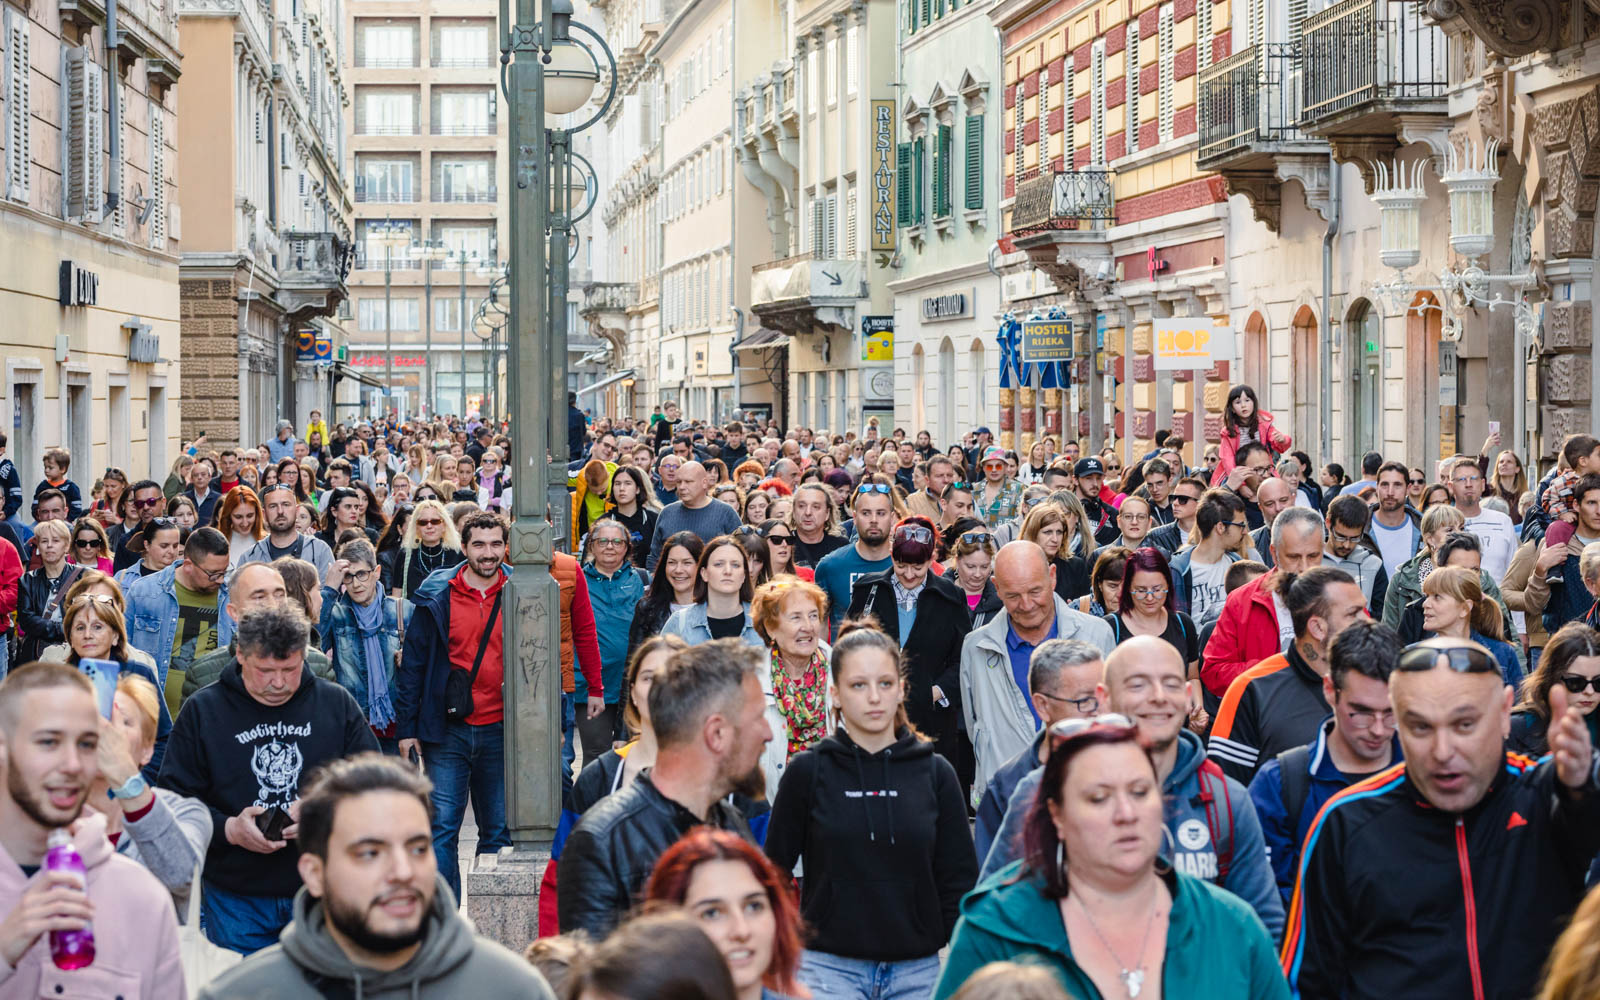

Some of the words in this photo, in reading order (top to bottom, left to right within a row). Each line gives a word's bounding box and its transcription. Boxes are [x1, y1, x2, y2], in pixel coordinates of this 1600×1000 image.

[876, 105, 892, 244] RESTAURANT
[1025, 324, 1070, 336] HOSTEL
[1032, 337, 1064, 346] RIJEKA
[1158, 330, 1210, 351] HOP
[394, 355, 427, 368] Bank
